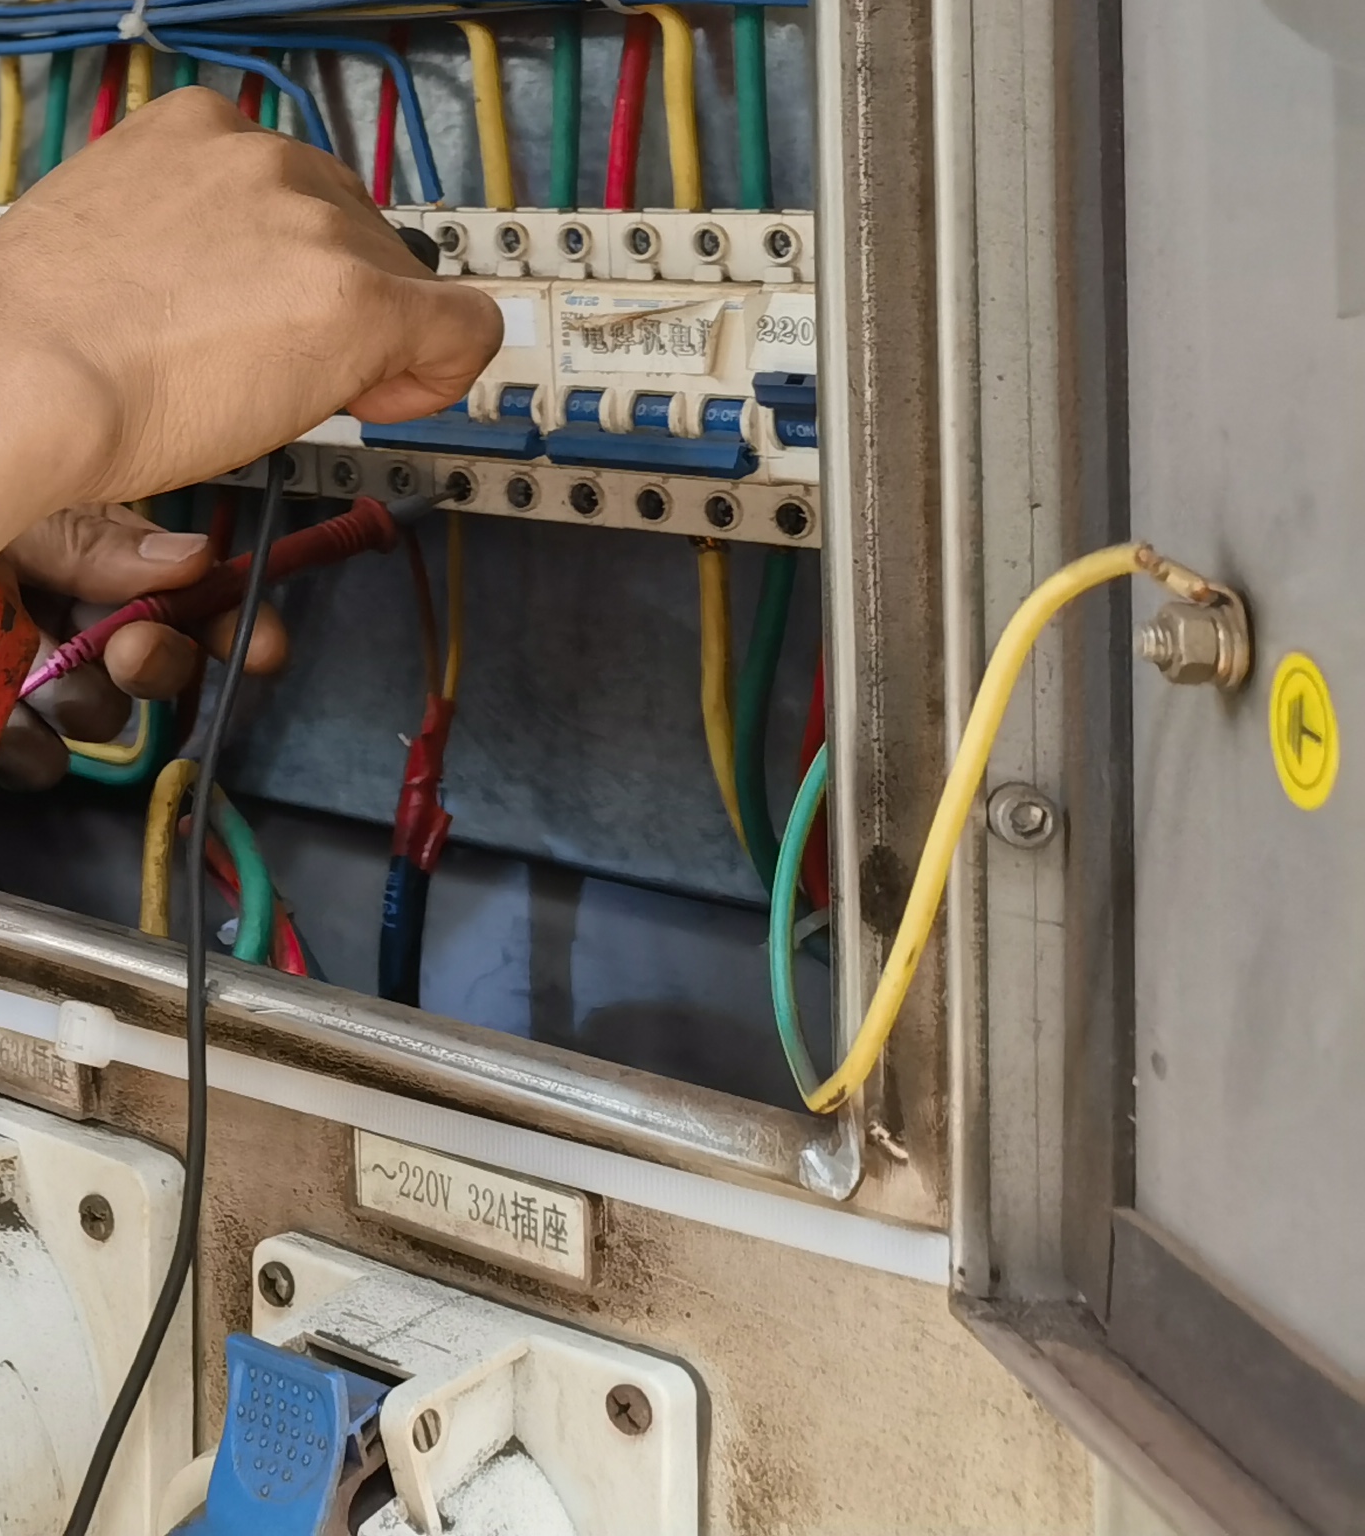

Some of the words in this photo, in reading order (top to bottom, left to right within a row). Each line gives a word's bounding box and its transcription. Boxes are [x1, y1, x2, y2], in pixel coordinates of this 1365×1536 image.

[756, 315, 816, 346] 220
[372, 1161, 453, 1212] ~220V
[468, 1183, 569, 1255] 32A插座
